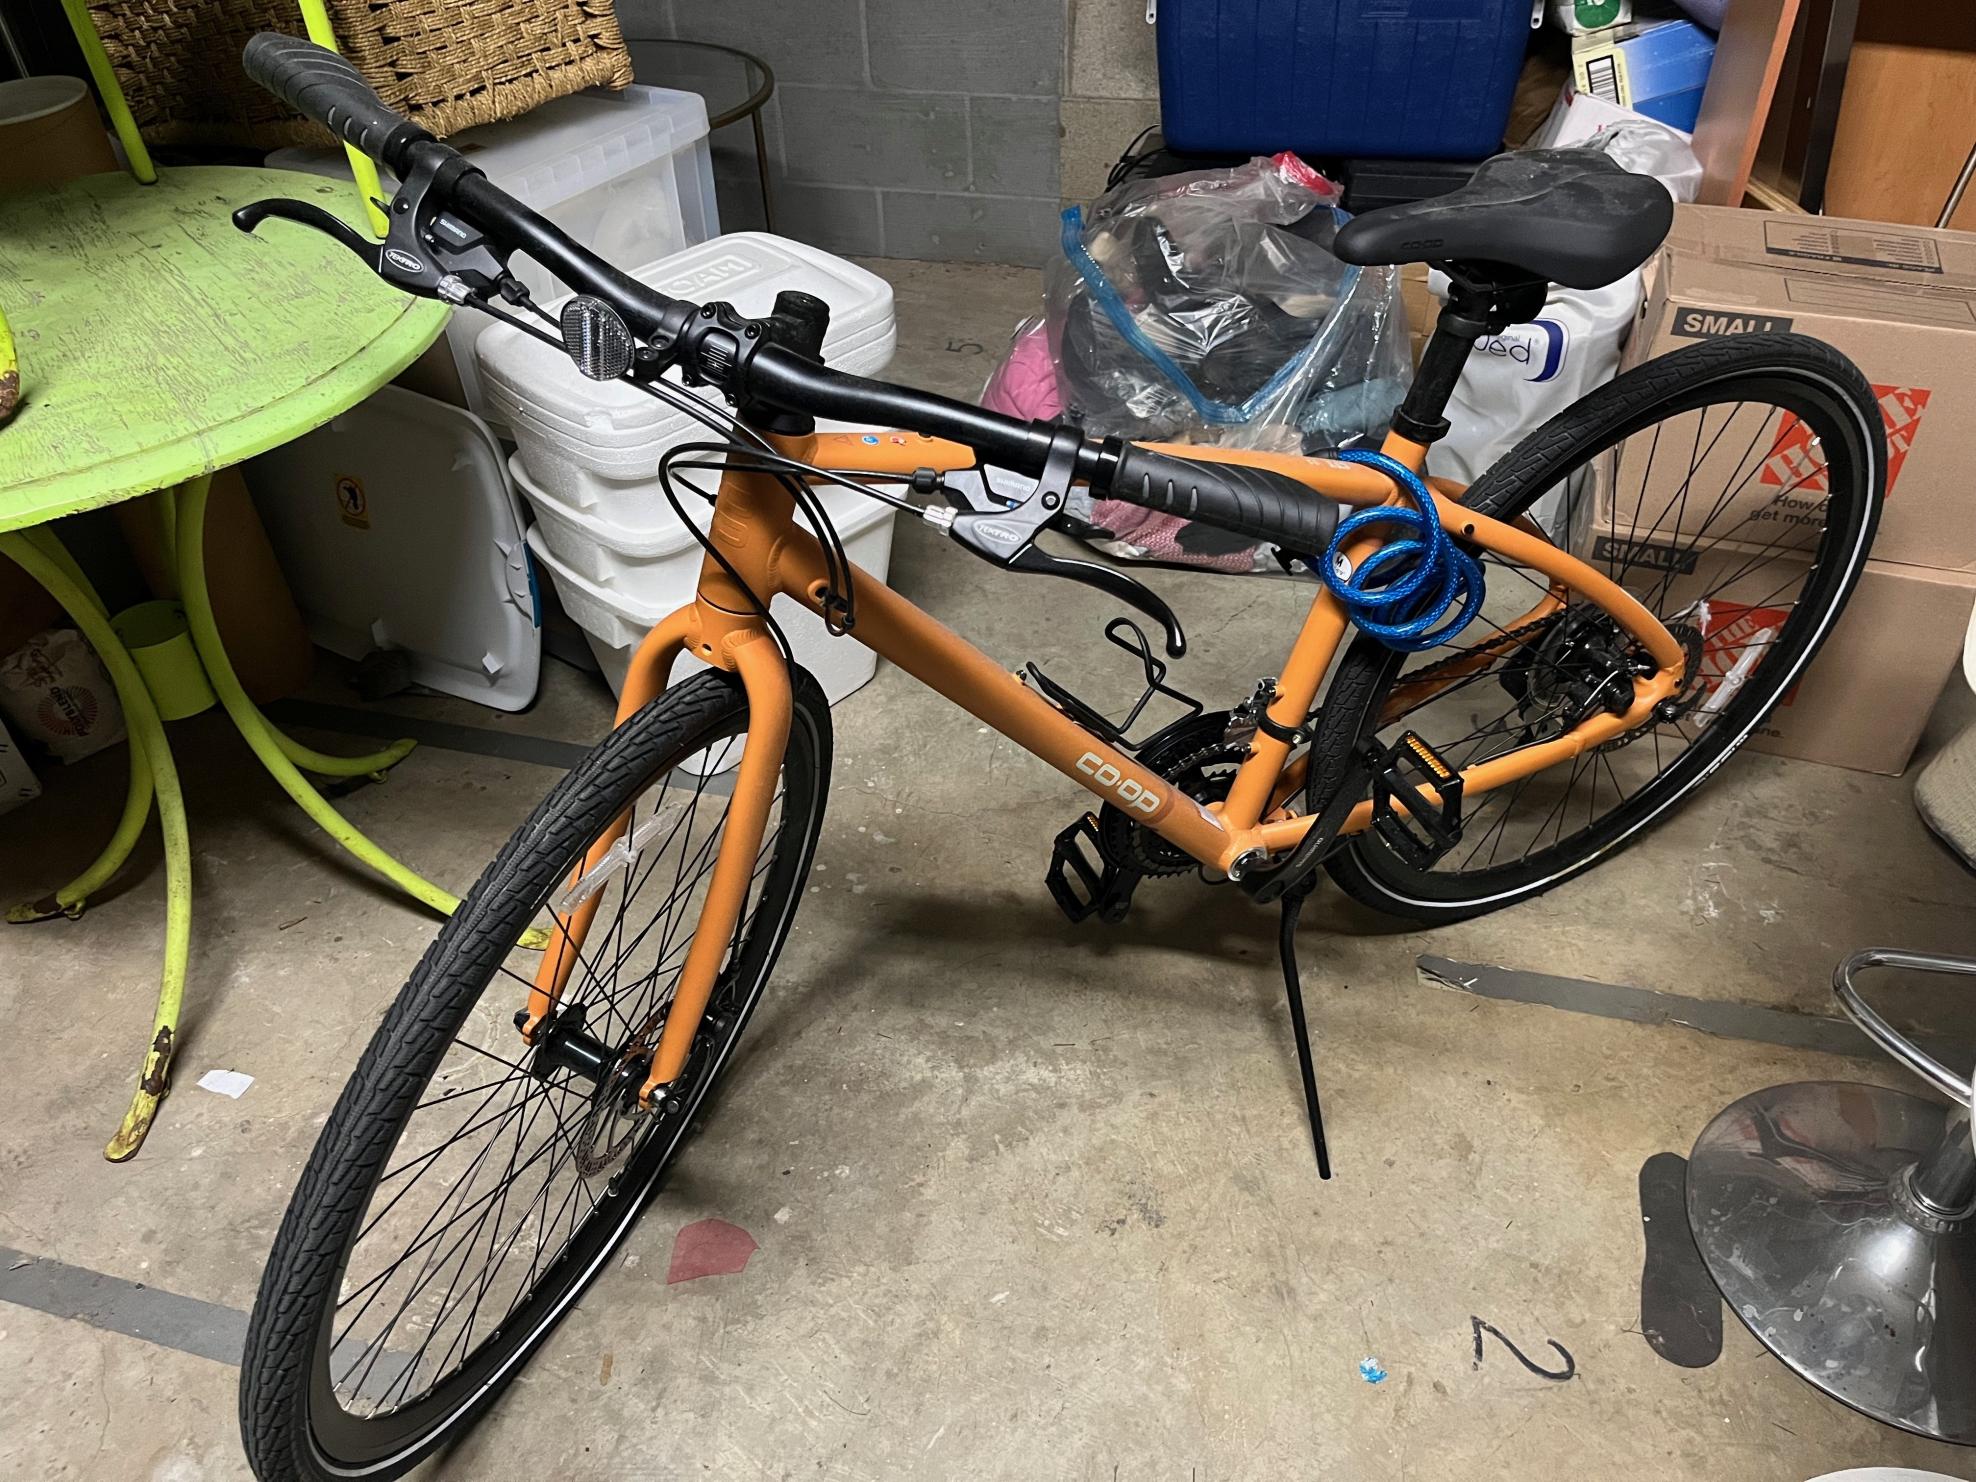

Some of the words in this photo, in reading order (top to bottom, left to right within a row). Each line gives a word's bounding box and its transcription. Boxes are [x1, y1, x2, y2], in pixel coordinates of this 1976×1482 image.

[1771, 494, 1815, 510] How
[1750, 510, 1779, 521] get
[1783, 513, 1827, 528] more
